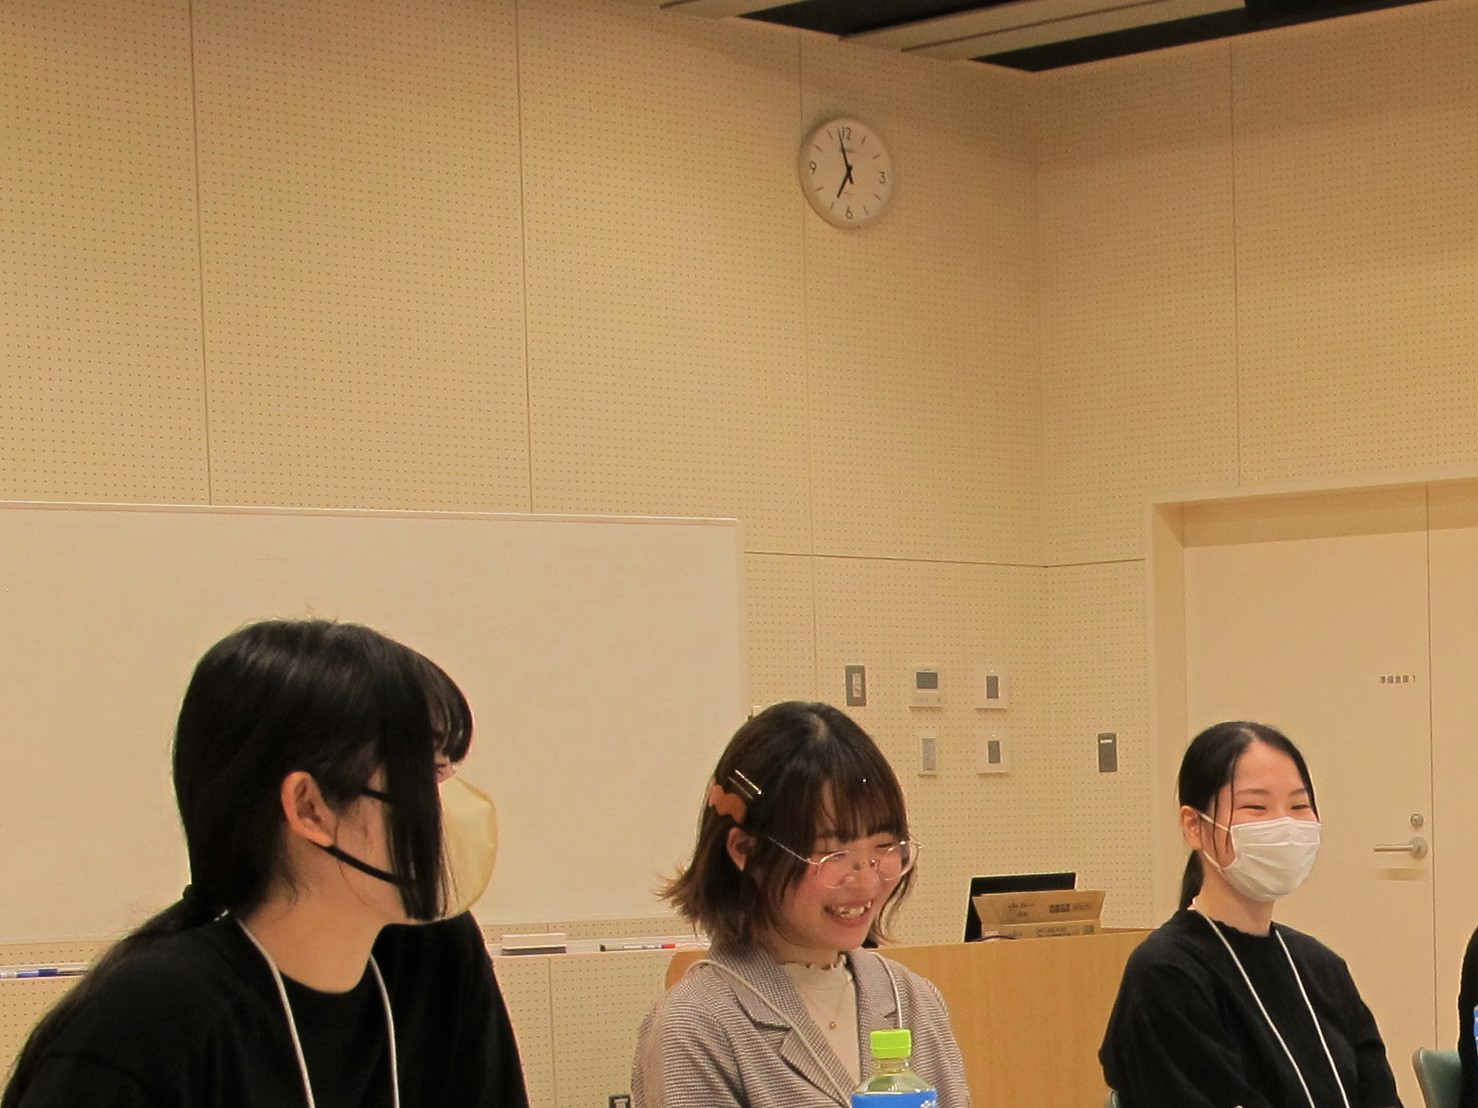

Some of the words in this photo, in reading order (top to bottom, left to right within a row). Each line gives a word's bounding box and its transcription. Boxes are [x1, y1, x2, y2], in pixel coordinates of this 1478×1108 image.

[808, 160, 817, 175] 9
[878, 171, 887, 185] 3
[845, 205, 854, 220] 6
